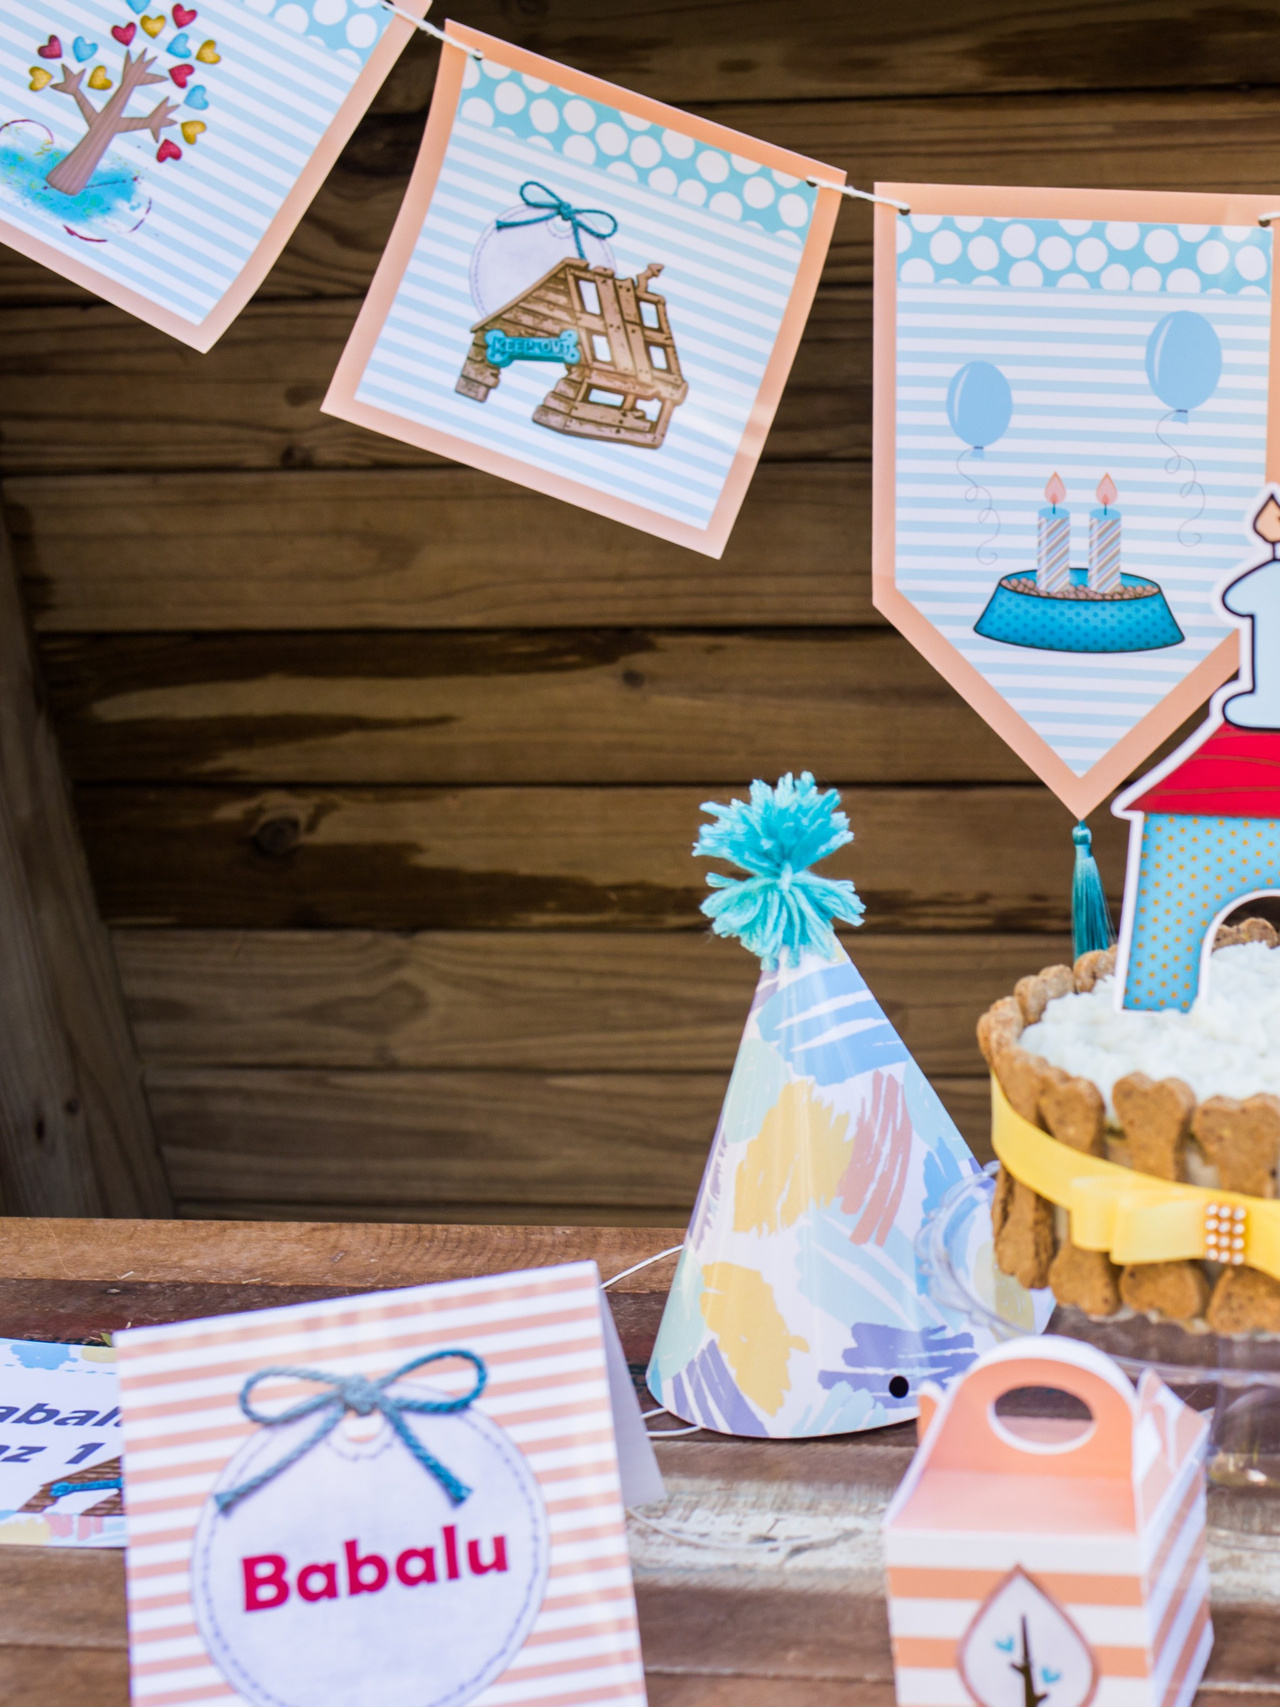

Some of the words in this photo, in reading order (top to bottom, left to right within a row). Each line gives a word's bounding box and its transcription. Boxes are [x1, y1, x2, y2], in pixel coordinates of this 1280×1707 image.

[0, 1445, 47, 1462] z
[65, 1442, 106, 1464] 1
[242, 1525, 508, 1612] Babalu
